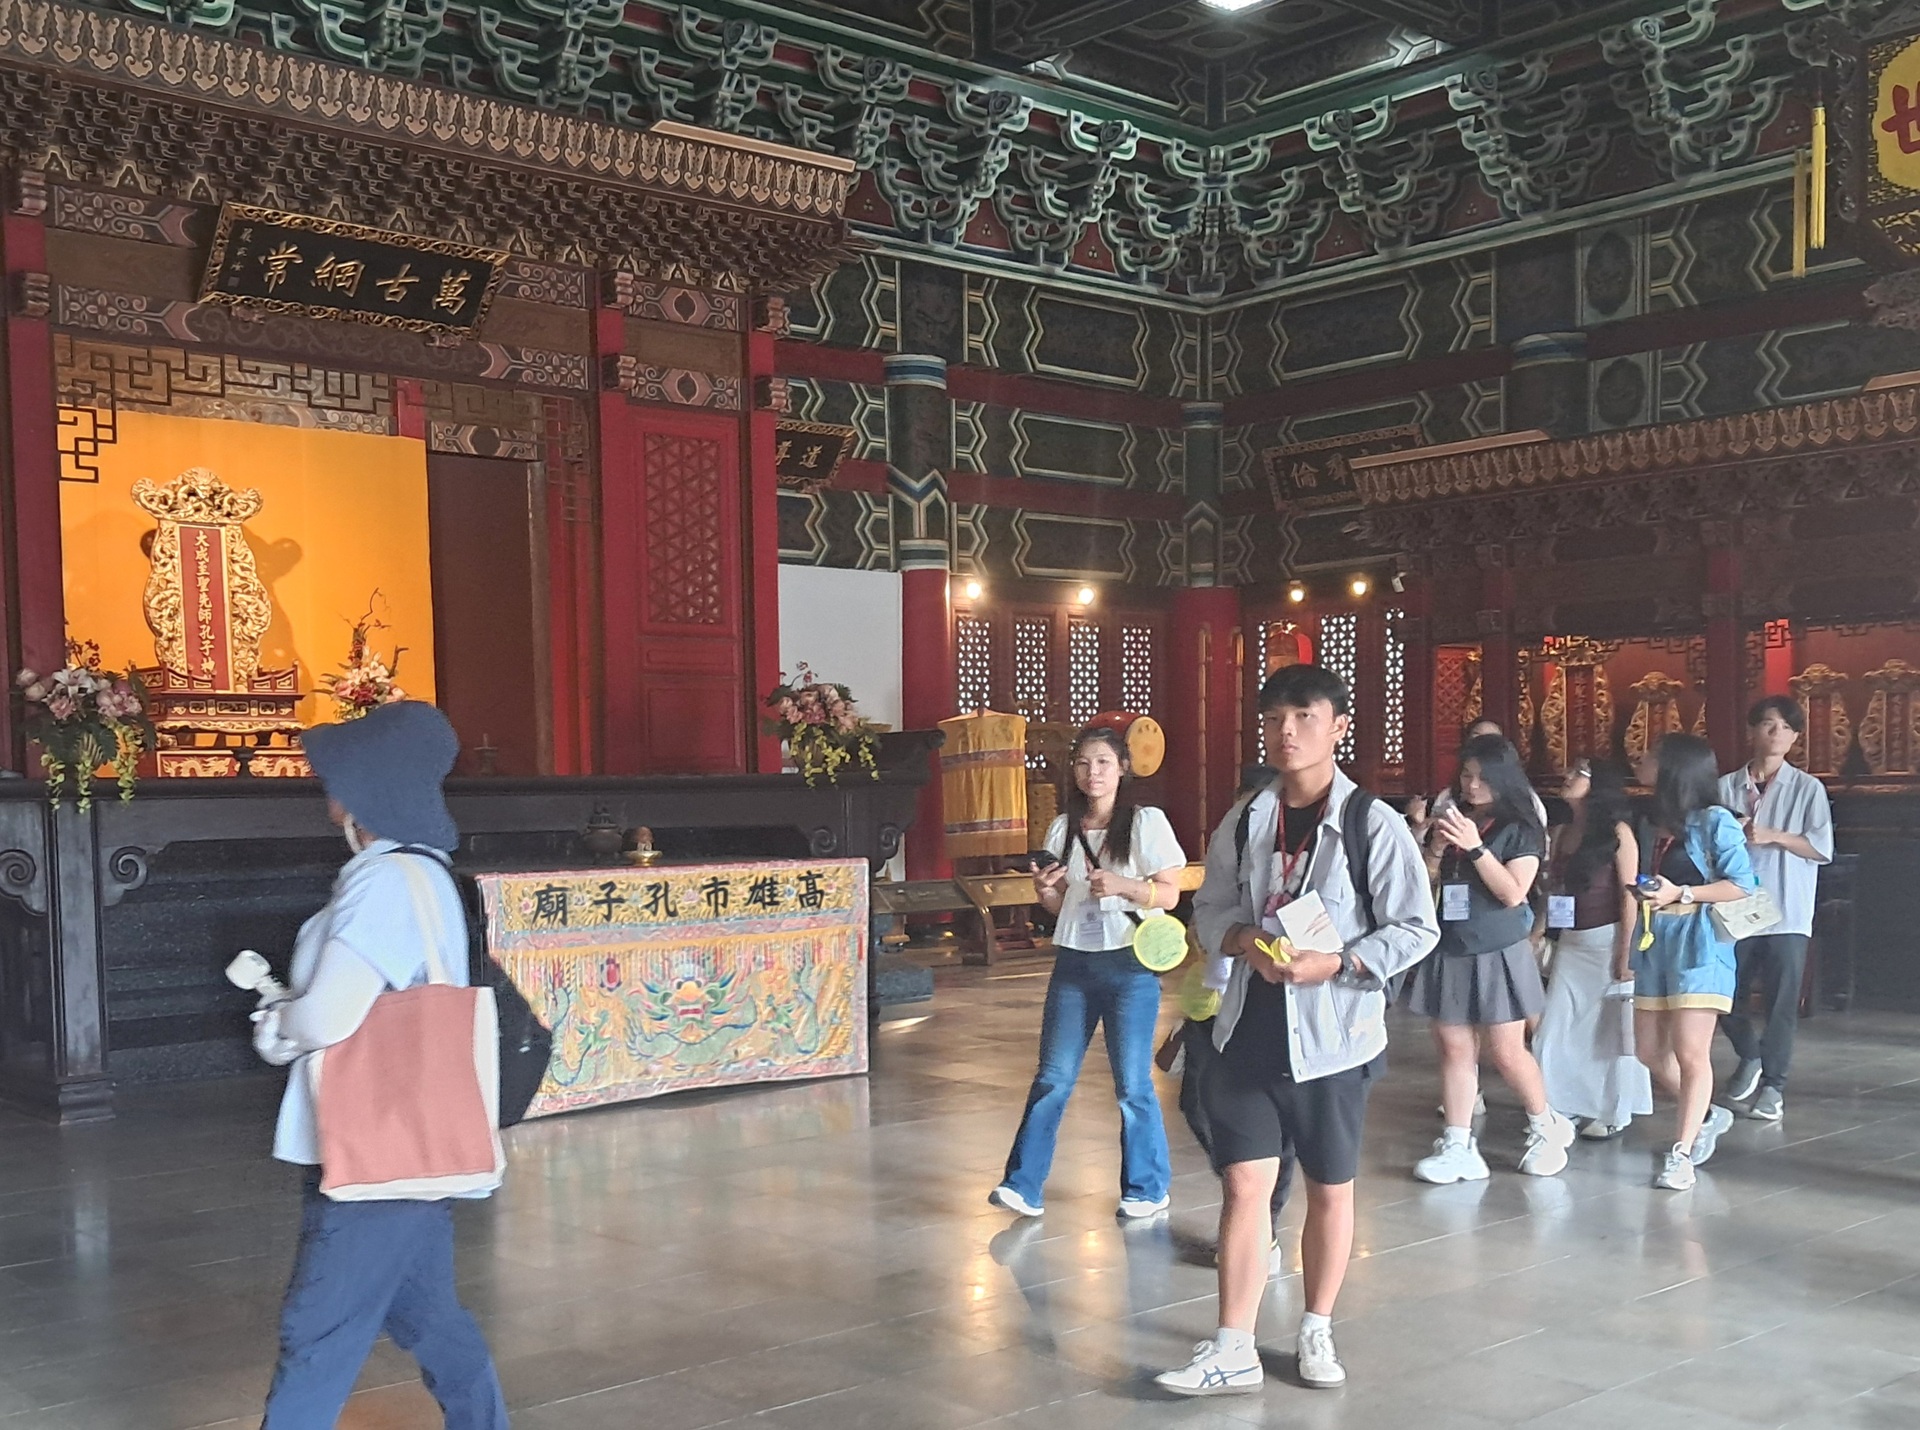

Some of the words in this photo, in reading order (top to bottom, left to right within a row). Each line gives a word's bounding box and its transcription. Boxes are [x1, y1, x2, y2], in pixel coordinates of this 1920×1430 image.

[258, 240, 472, 315] 萬古綱常
[194, 530, 216, 679] 大成至聖先師孔子神
[532, 870, 826, 926] 高雄市孔子廟
